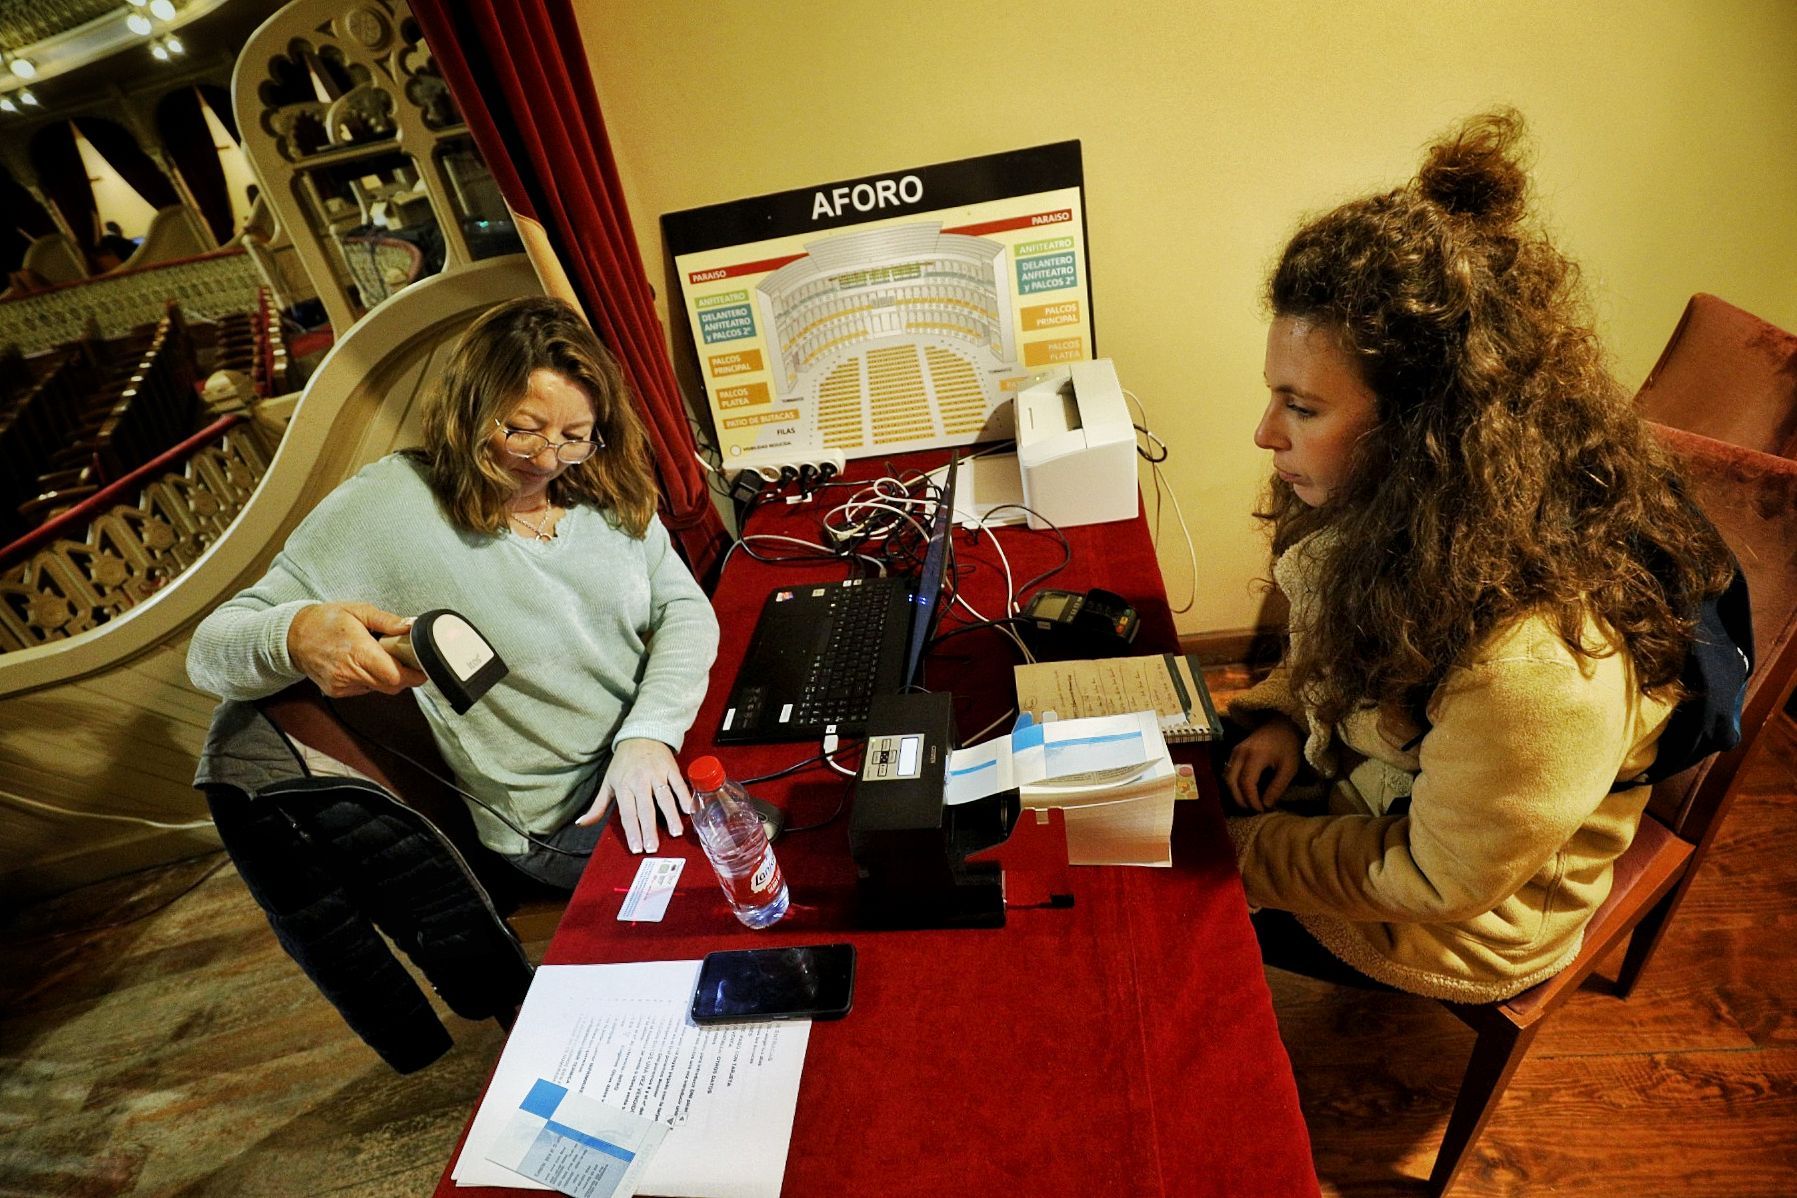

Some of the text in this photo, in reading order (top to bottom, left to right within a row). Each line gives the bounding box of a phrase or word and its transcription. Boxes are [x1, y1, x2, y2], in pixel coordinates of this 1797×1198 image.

[811, 175, 923, 220] AFORO
[1031, 212, 1070, 226] PARAISO
[1019, 239, 1072, 254] ANFITEATRO
[1022, 255, 1073, 271] DELANTERO
[692, 270, 727, 282] PARAISO
[1022, 266, 1074, 281] ANFITEATRO
[1032, 277, 1064, 290] PALCOS
[698, 292, 746, 306] ANFITEATRO
[701, 308, 748, 322] DELANTERO
[1045, 304, 1078, 315] PALCOS
[704, 317, 751, 332] ANFITEATRO
[1036, 314, 1078, 326] PRINCIPAL
[713, 329, 742, 340] PALCOS
[712, 354, 741, 365] PALCOS
[714, 363, 751, 375] PRINCIPAL
[720, 388, 749, 398] PALCOS
[721, 397, 750, 408] PLATEA
[725, 411, 795, 428] PATIO DE BUTACAS
[776, 427, 796, 436] FILAS
